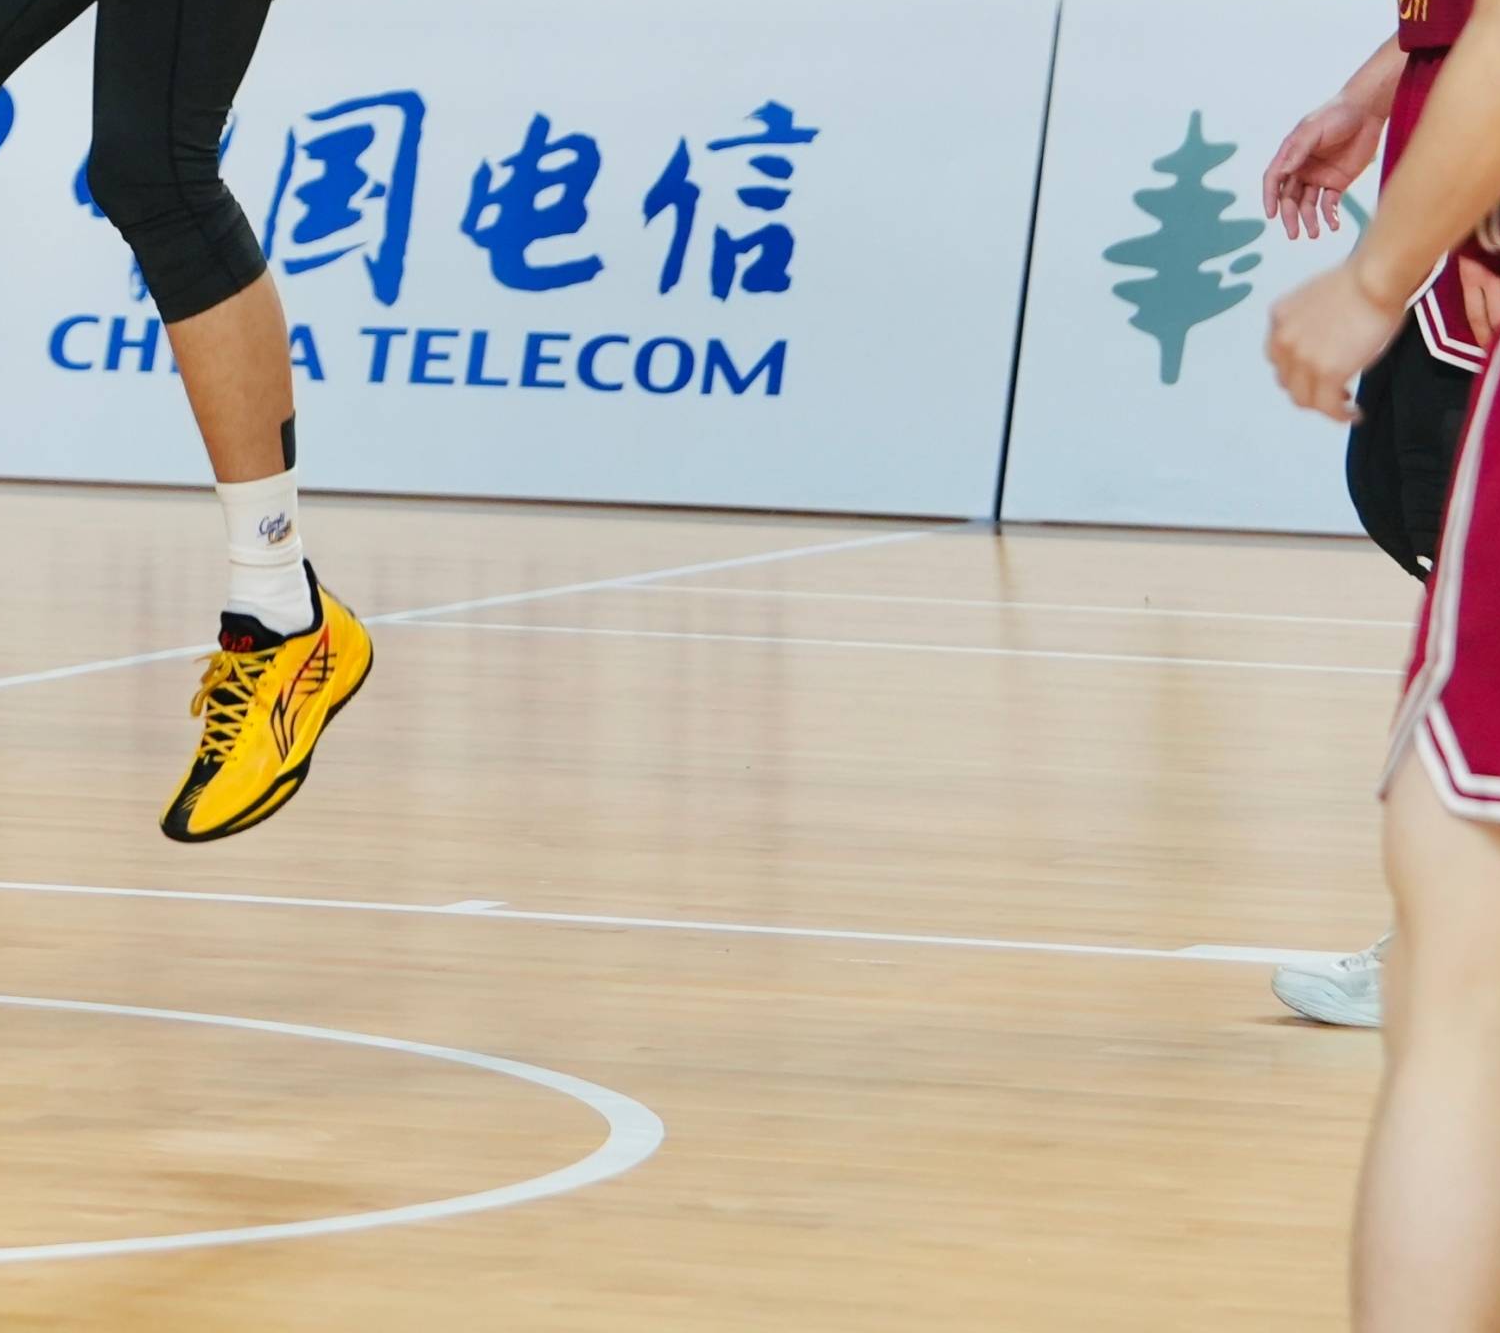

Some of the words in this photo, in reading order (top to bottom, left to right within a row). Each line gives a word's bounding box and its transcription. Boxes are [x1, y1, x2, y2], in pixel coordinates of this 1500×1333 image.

[73, 88, 821, 307] 国电信
[46, 312, 326, 385] CHA
[363, 329, 790, 399] TELECOM
